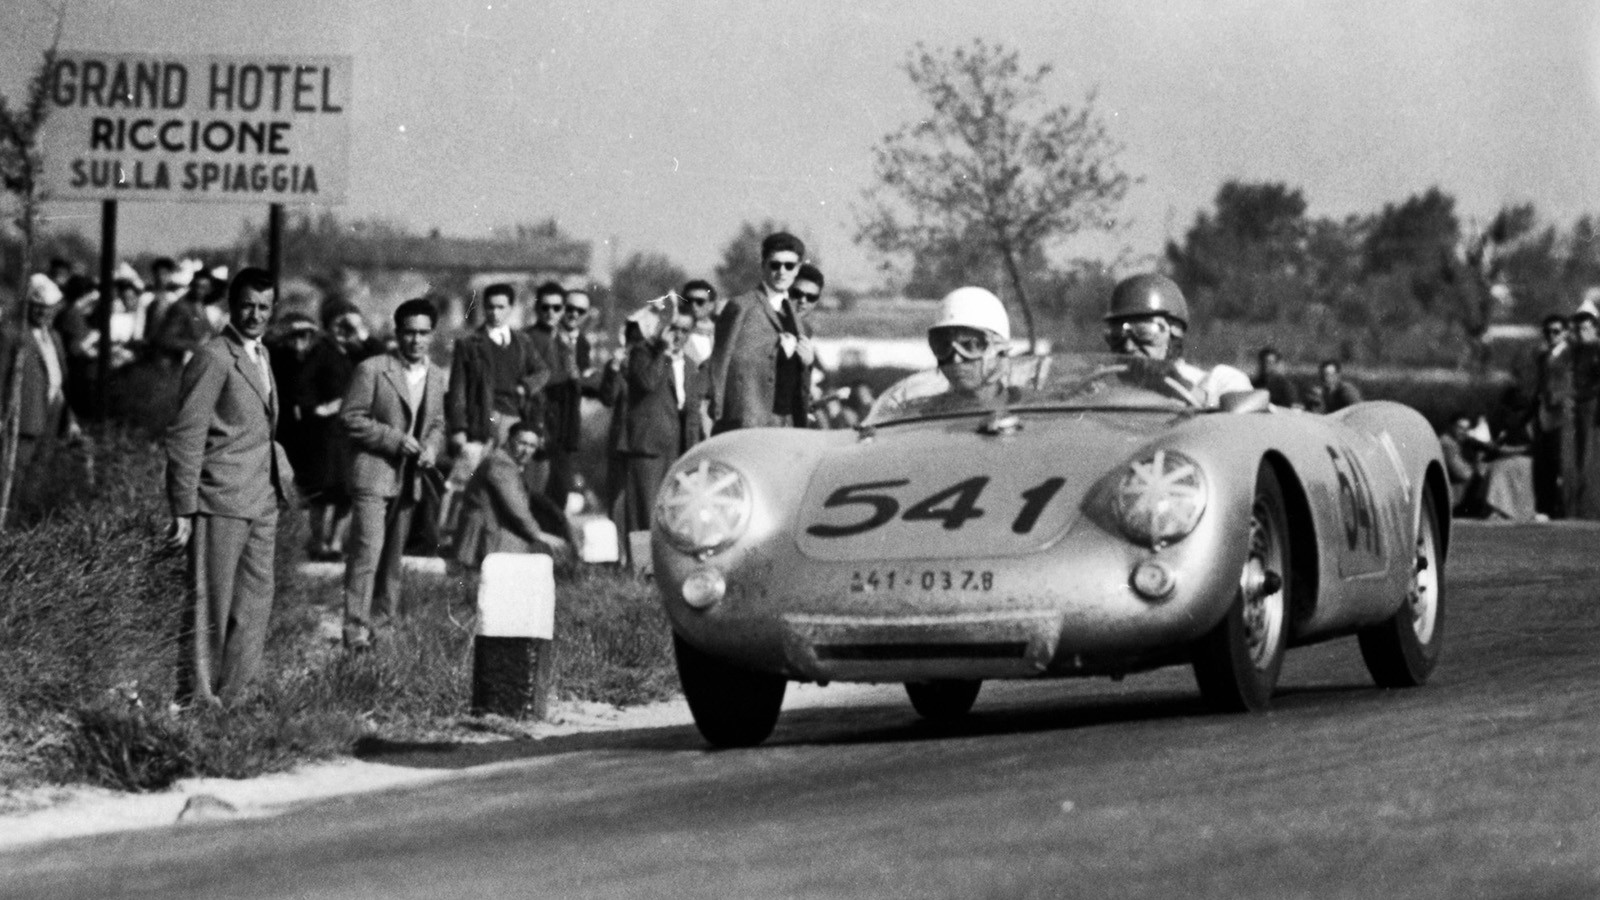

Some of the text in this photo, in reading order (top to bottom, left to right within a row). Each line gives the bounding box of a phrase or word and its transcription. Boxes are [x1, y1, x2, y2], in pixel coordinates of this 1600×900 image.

[52, 59, 342, 113] GRAND HOTEL
[91, 117, 291, 154] RICCIONE
[70, 158, 318, 194] SULLA SPIAGGIA
[806, 475, 1067, 539] 541
